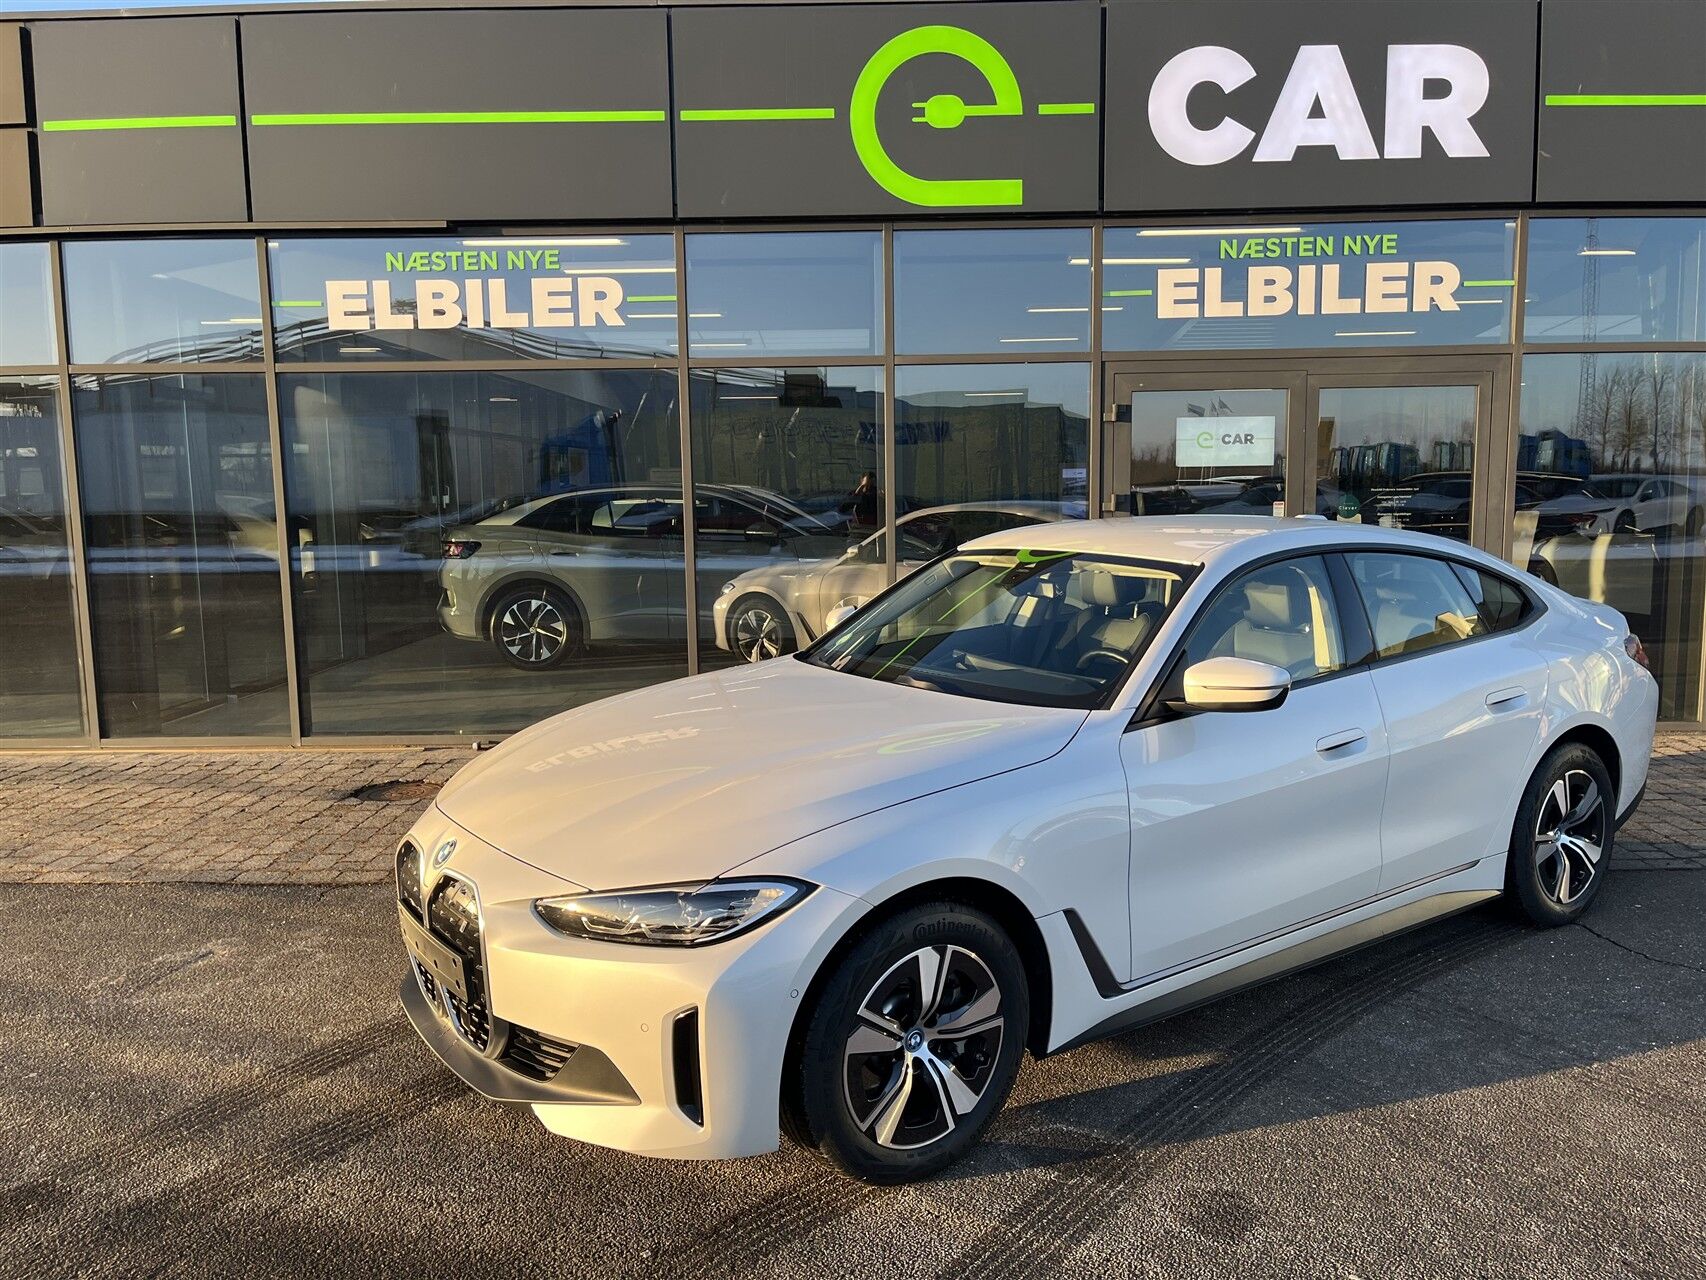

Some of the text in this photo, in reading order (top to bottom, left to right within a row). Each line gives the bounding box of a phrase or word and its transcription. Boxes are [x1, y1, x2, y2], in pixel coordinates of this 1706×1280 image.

[1148, 44, 1490, 165] CAR
[1219, 233, 1399, 259] NÆSTEN NYE
[385, 250, 560, 272] NÆSTEN NYE
[1157, 261, 1461, 319] ELBILER
[325, 276, 626, 331] ELBILER
[1221, 433, 1255, 446] CAR
[912, 917, 993, 941] Continental
